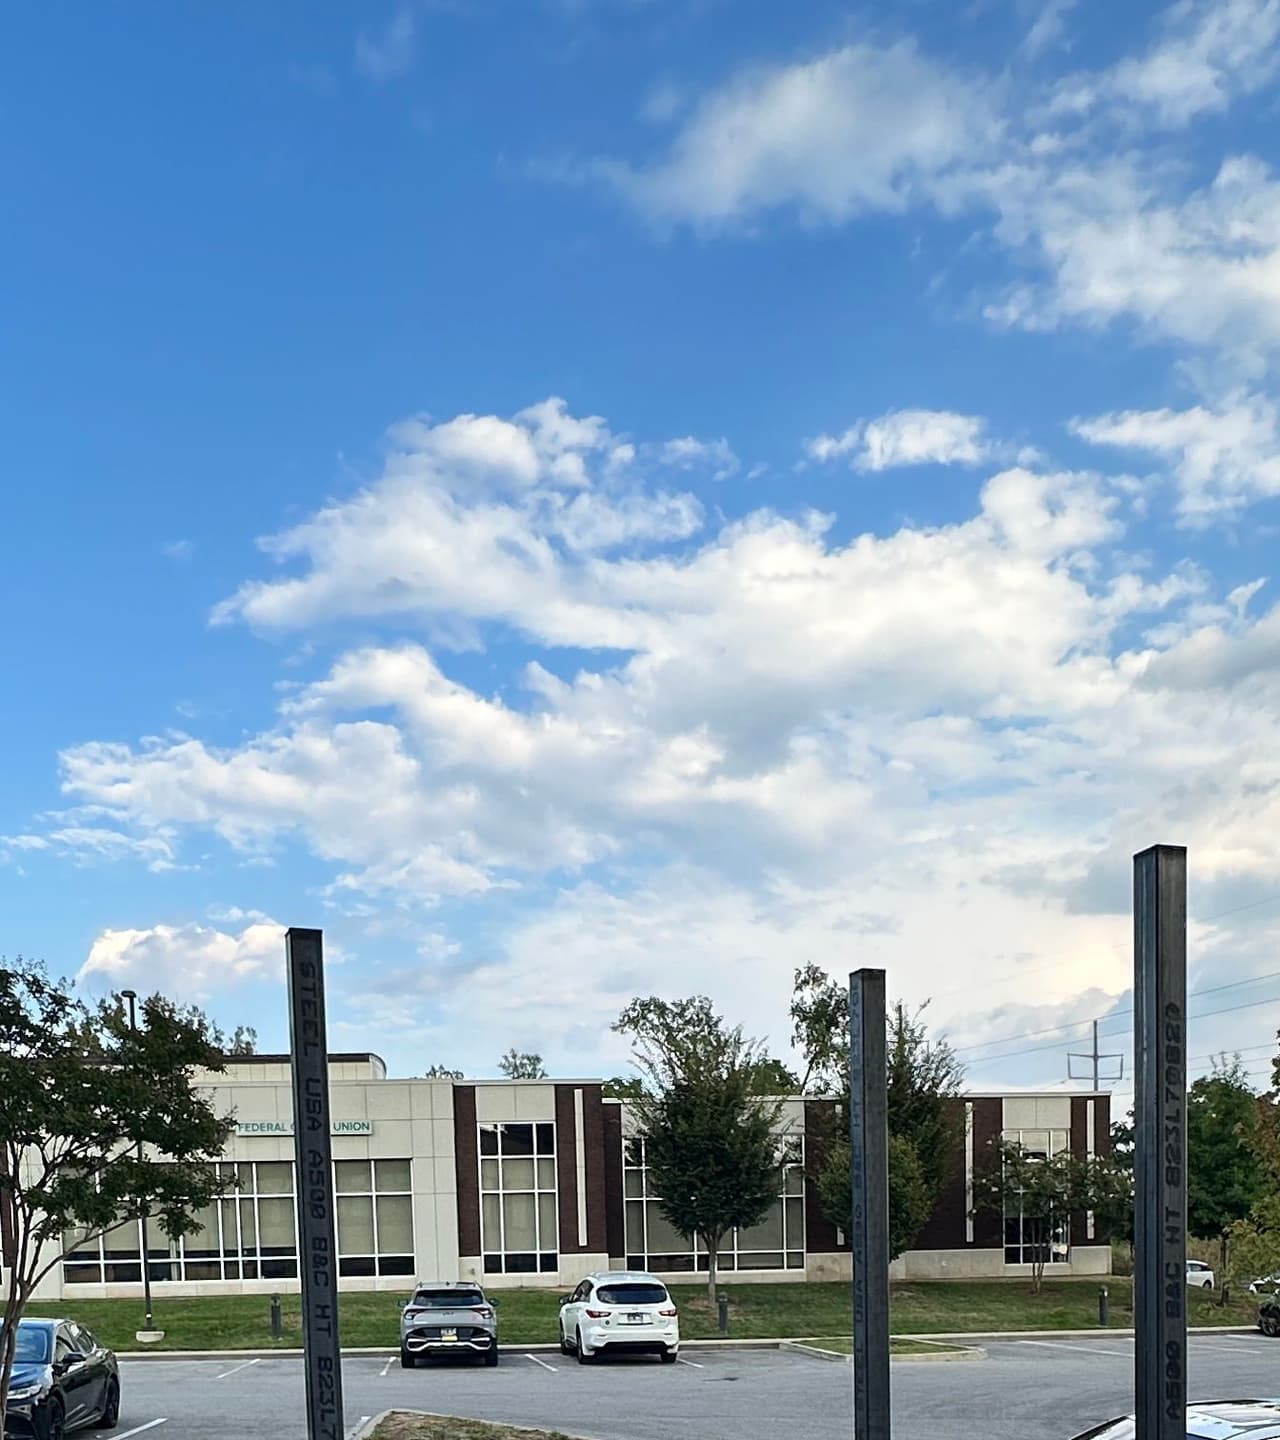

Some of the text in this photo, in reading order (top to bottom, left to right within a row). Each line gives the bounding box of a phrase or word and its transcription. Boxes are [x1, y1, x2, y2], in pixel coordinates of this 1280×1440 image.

[300, 960, 321, 1057] STEEL
[238, 1122, 288, 1132] FEDERAL
[333, 1121, 370, 1132] UNION
[304, 1077, 324, 1132] USA
[308, 1149, 327, 1220] A500
[1164, 1205, 1181, 1245] HT
[311, 1236, 330, 1287] B&C
[1164, 1261, 1182, 1319] B&C
[314, 1303, 333, 1339] HT
[1165, 1340, 1182, 1422] A500
